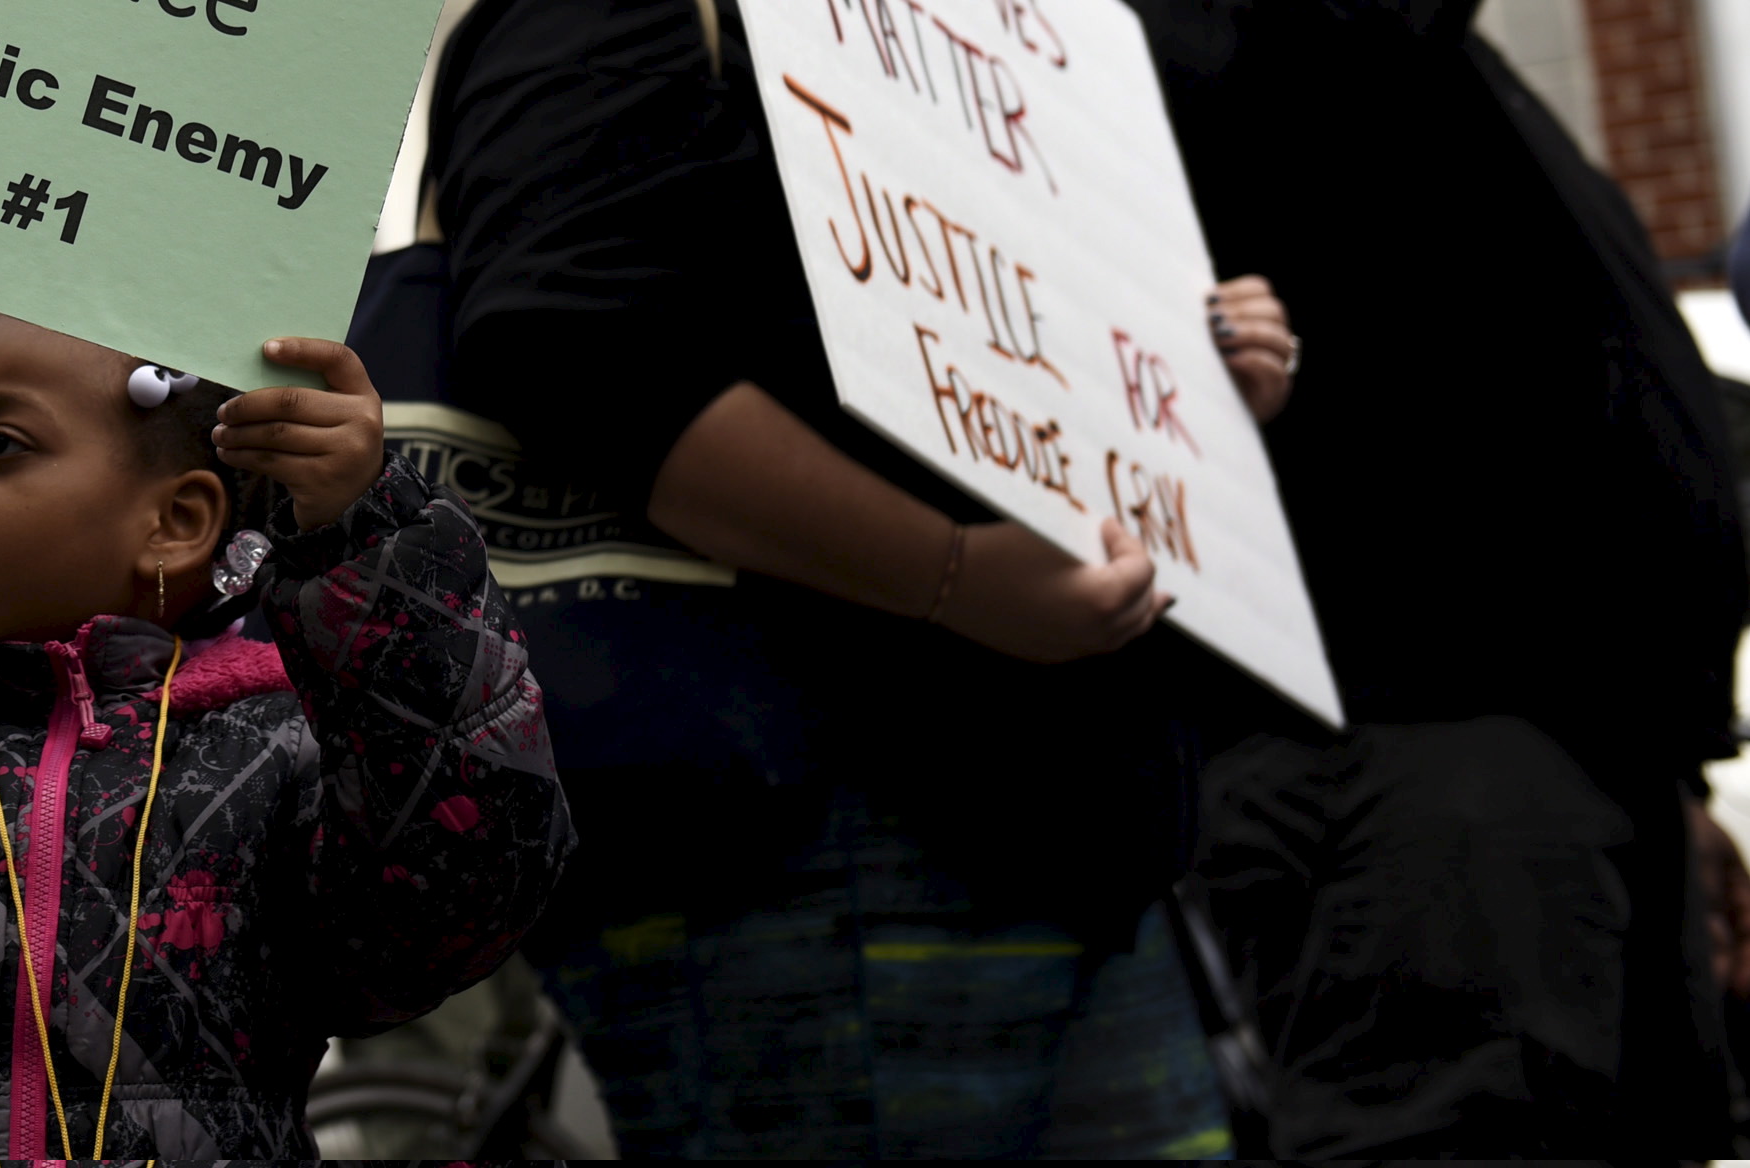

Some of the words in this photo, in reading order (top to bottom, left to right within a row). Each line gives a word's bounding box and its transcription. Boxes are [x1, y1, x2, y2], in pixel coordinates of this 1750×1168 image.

[0, 172, 89, 245] #1
[81, 74, 330, 210] Enemy
[782, 72, 1070, 390] JUSTICE
[1110, 325, 1202, 460] FOR
[912, 321, 1087, 515] FREDDIE
